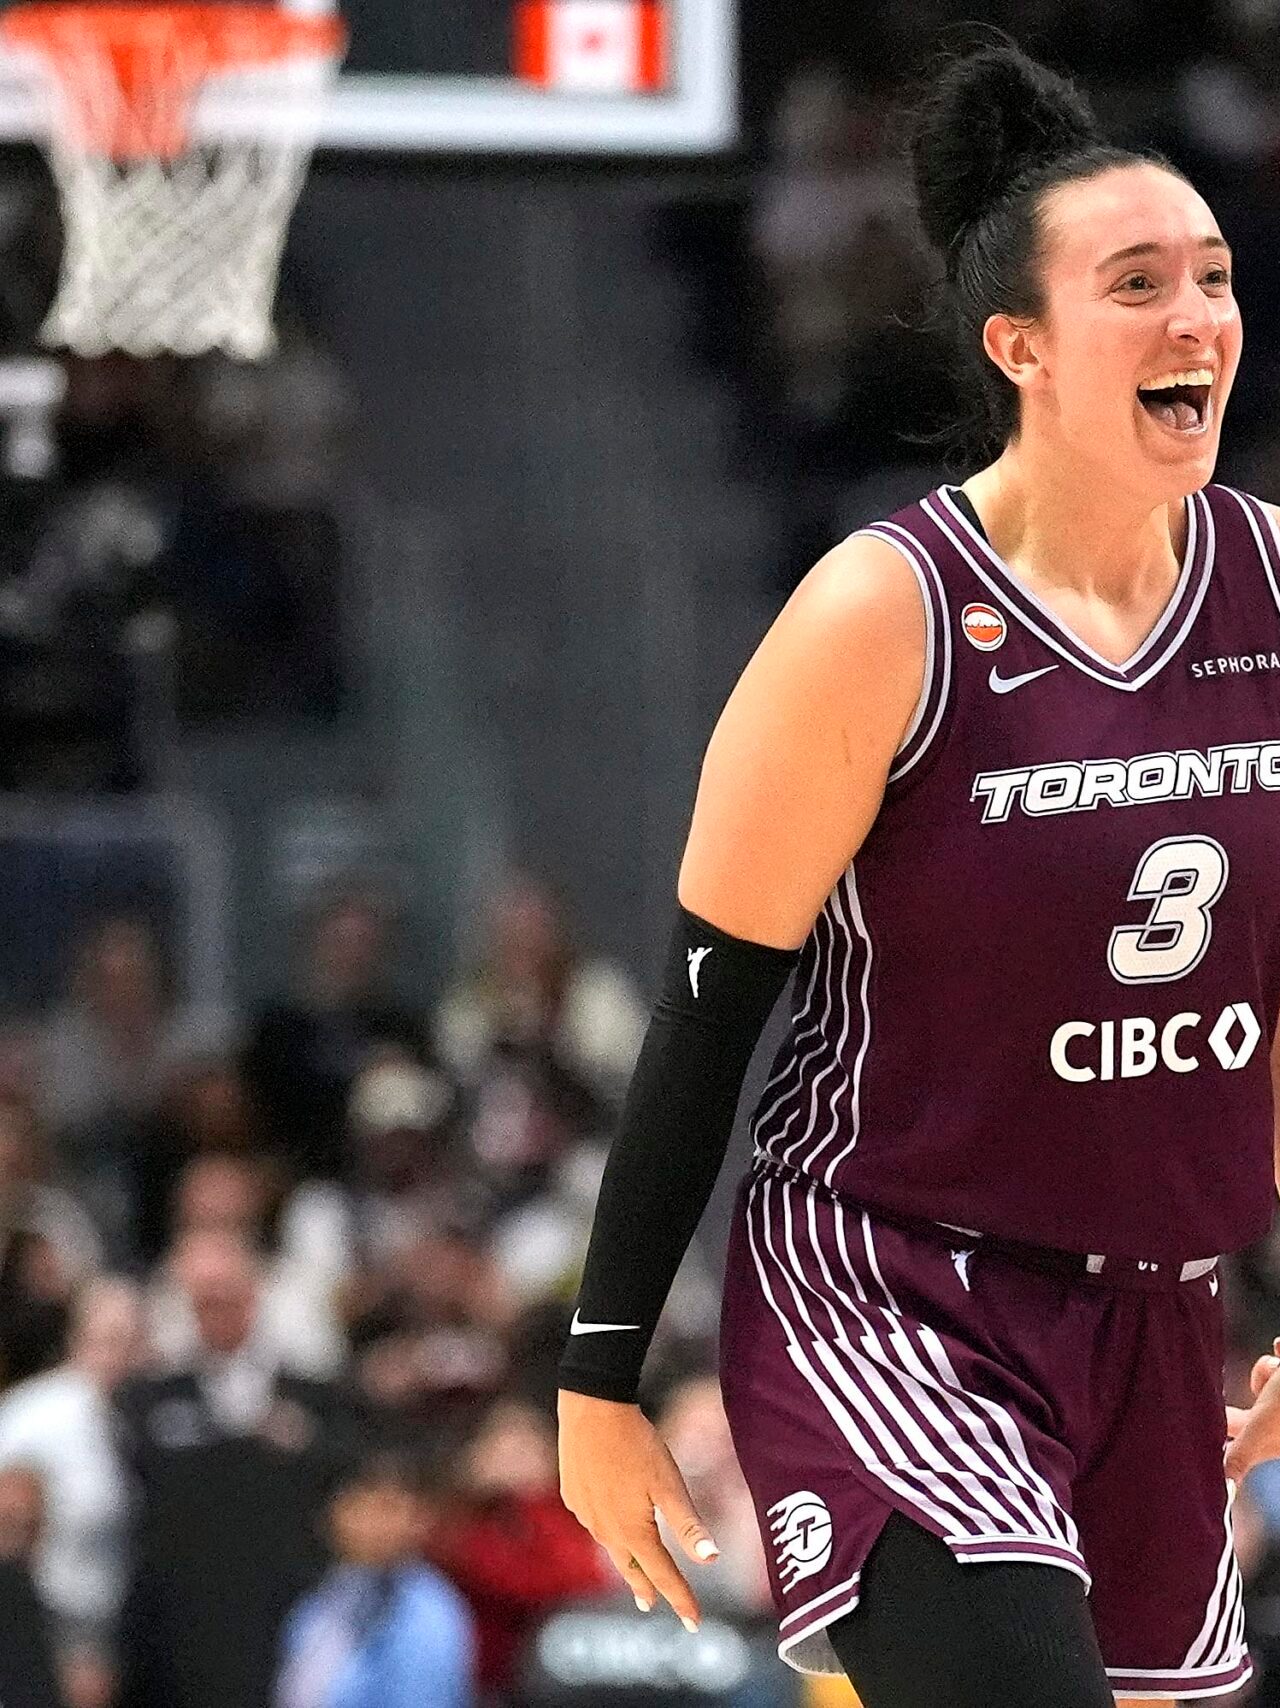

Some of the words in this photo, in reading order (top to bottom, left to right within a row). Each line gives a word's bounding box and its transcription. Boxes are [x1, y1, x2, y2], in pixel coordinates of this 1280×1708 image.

[1191, 652, 1280, 678] SEPHORA
[1107, 834, 1229, 985] 3
[1050, 1012, 1201, 1083] CIBC
